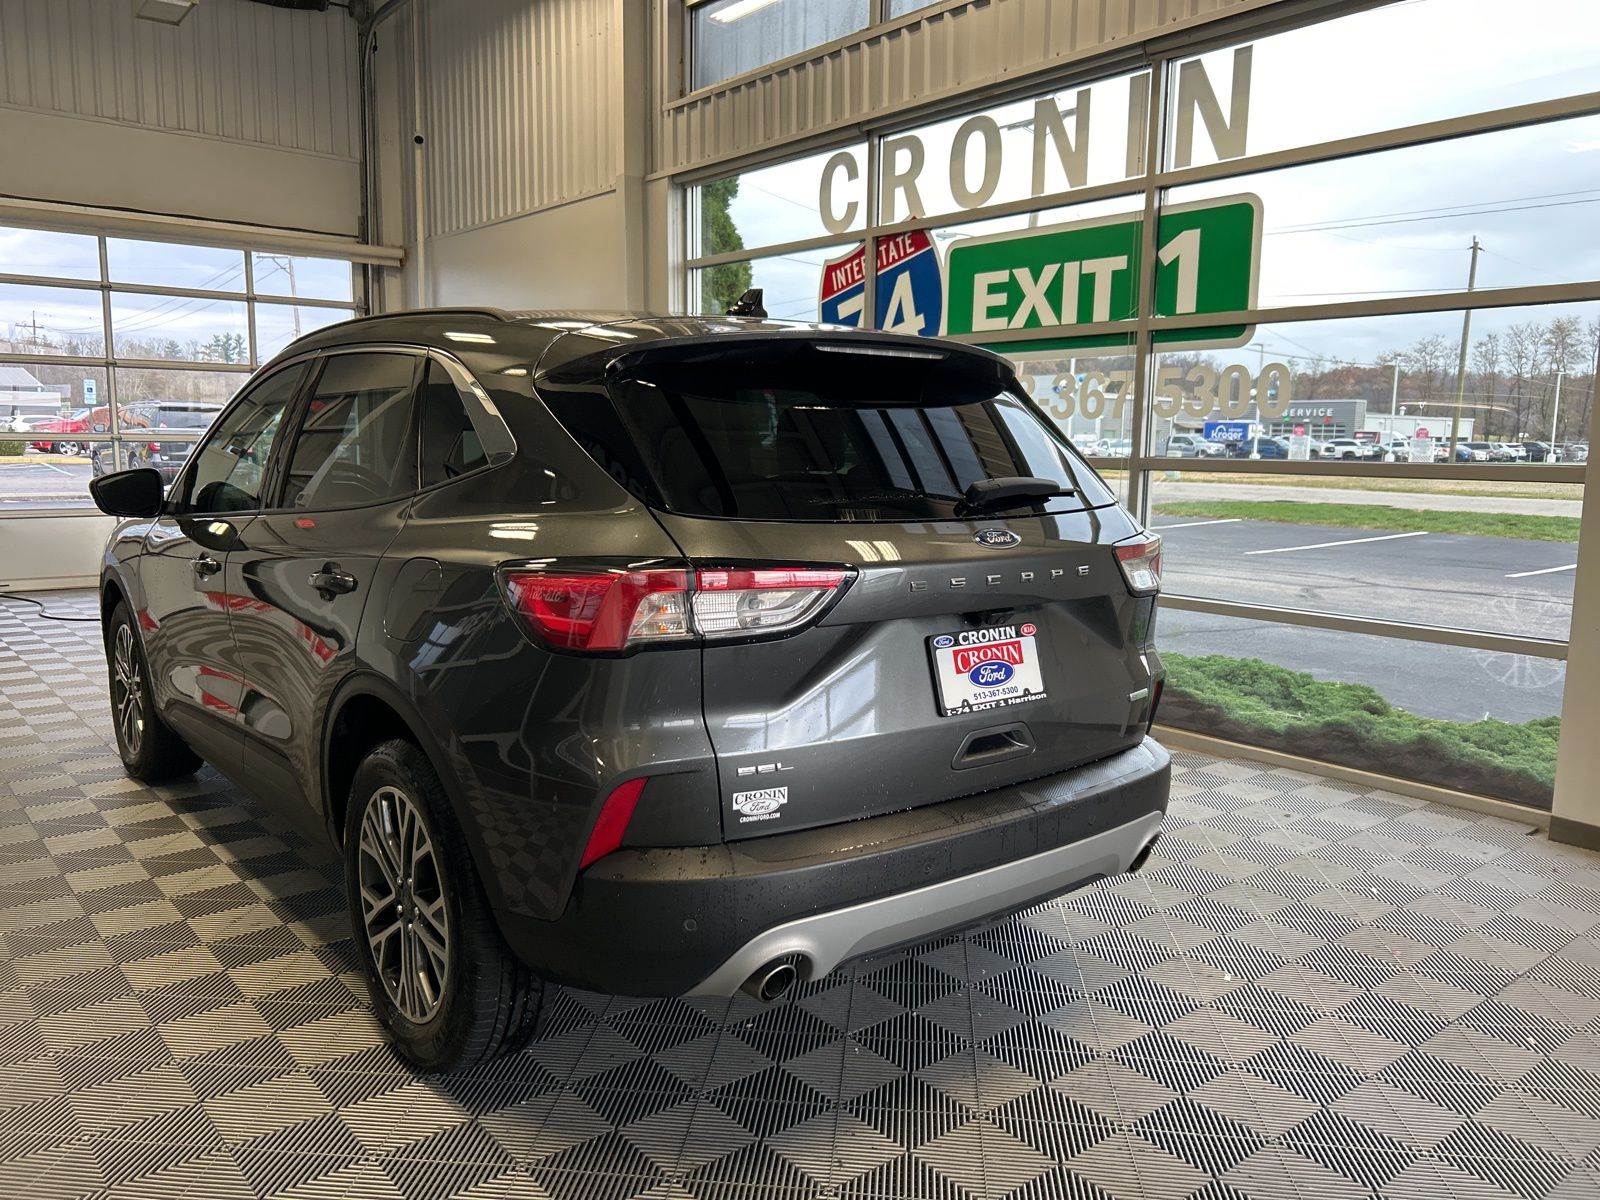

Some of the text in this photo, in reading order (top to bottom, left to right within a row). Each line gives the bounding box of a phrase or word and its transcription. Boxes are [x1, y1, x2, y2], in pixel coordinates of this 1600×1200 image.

[819, 44, 1253, 234] CRONIN
[831, 232, 915, 292] INTETATE
[972, 228, 1201, 332] EXIT 1
[1282, 407, 1334, 417] SERVICE
[1211, 425, 1243, 440] Kroger
[910, 565, 1090, 593] ESCAPE
[958, 625, 1017, 646] CRONIN
[957, 643, 1021, 673] CRONIN
[978, 664, 1007, 684] Ford
[973, 685, 1019, 701] 513-367-5300
[946, 706, 970, 717] I-74
[972, 701, 997, 712] EXIT
[1008, 693, 1047, 705] Harrison
[735, 788, 787, 805] CRONIN
